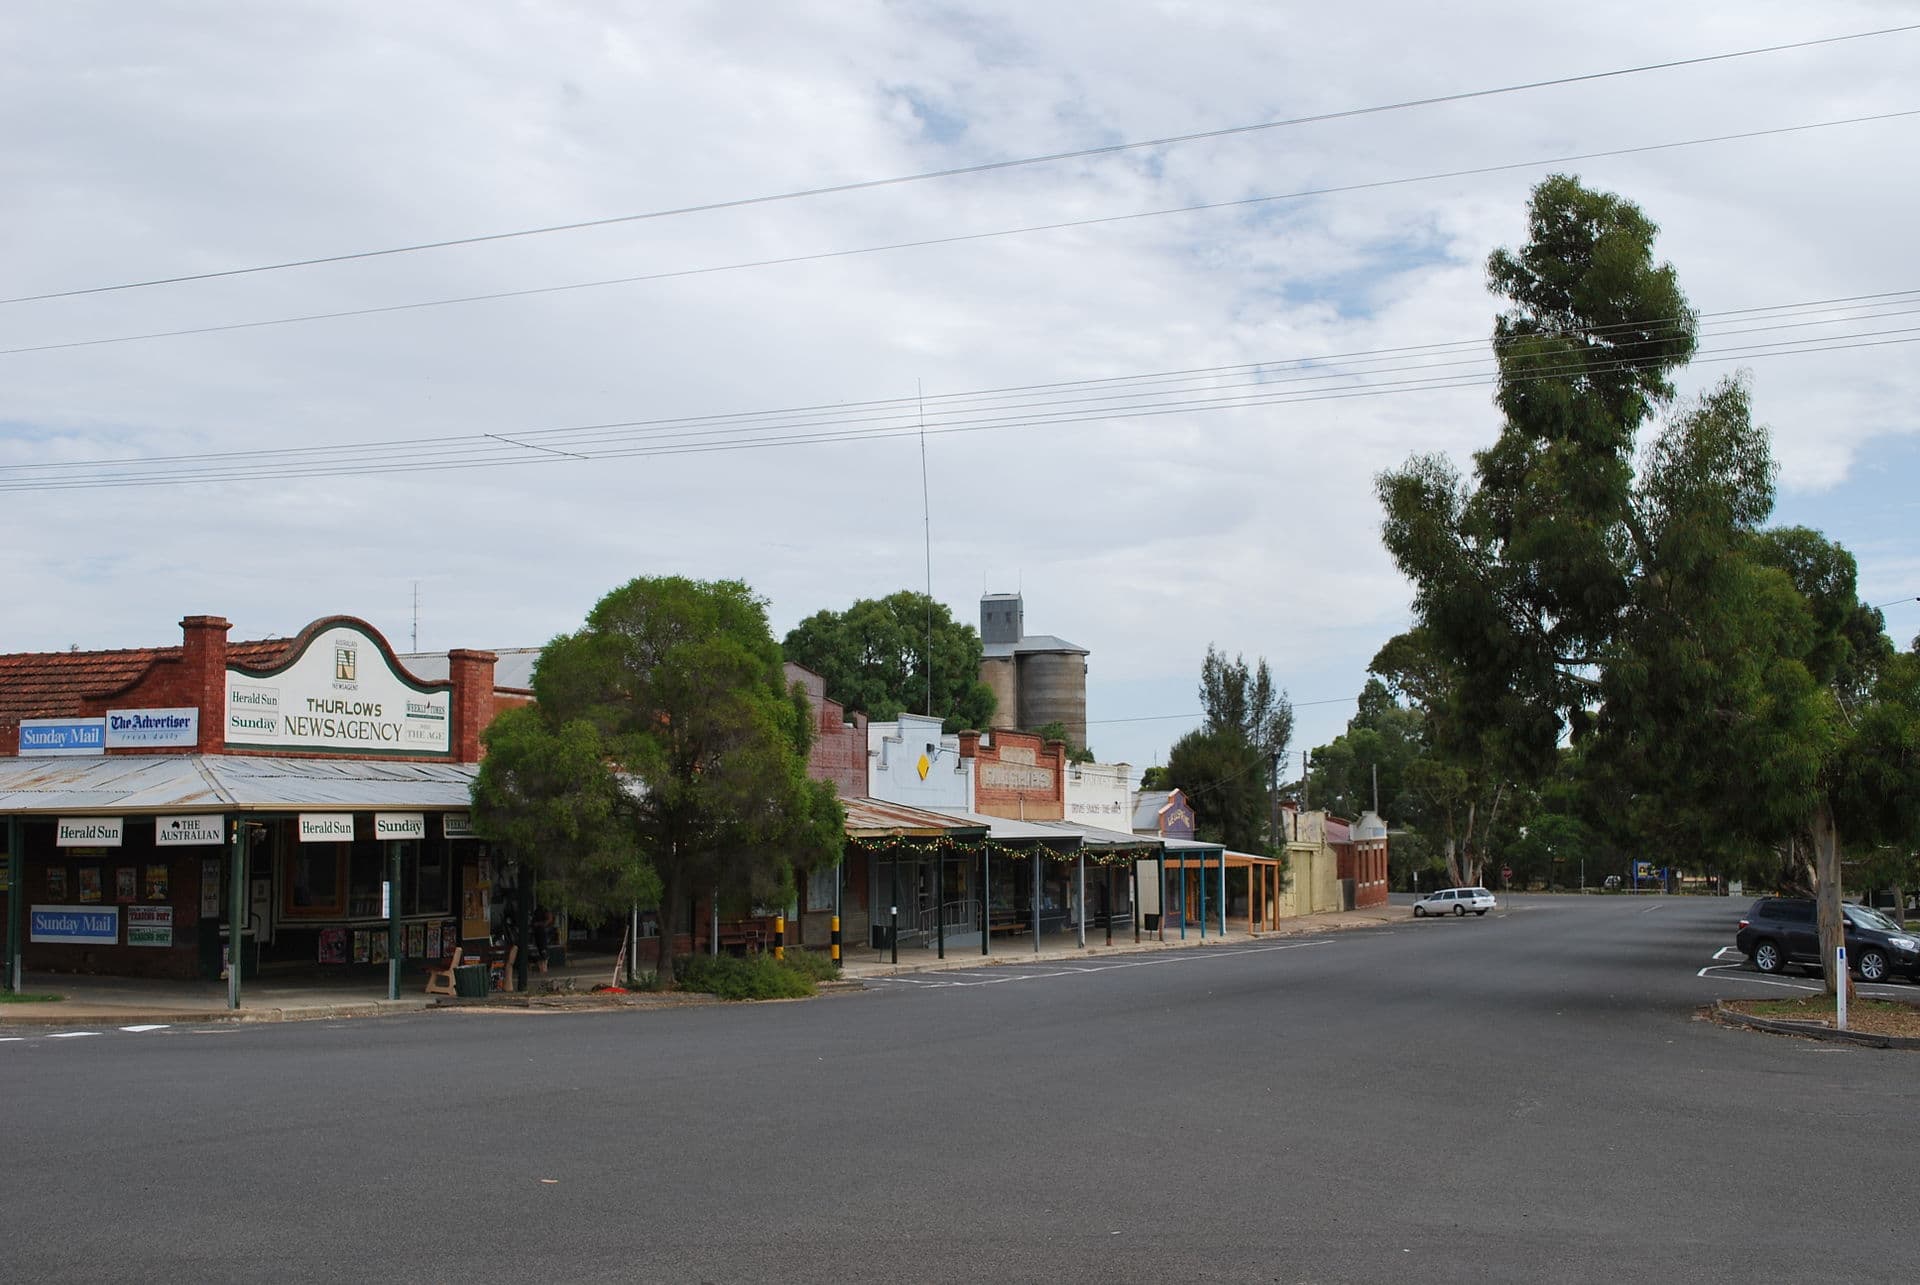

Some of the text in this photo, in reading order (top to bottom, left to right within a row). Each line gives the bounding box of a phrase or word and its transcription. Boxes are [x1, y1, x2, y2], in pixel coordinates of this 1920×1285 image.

[232, 691, 277, 706] Herald Sun
[306, 698, 382, 717] THURLOWS
[110, 714, 191, 730] The Advertiser
[231, 715, 277, 733] Sunday
[284, 715, 403, 742] NEWSAGENCY
[24, 727, 99, 748] Sunday Mail
[152, 733, 179, 741] daily
[407, 730, 425, 739] THE
[60, 826, 119, 839] Herald Sun
[181, 820, 201, 830] THE
[302, 820, 351, 834] Herald Sun
[377, 819, 423, 836] Sunday
[160, 829, 220, 841] AUSTRALIAN
[36, 915, 111, 934] Sunday Mail
